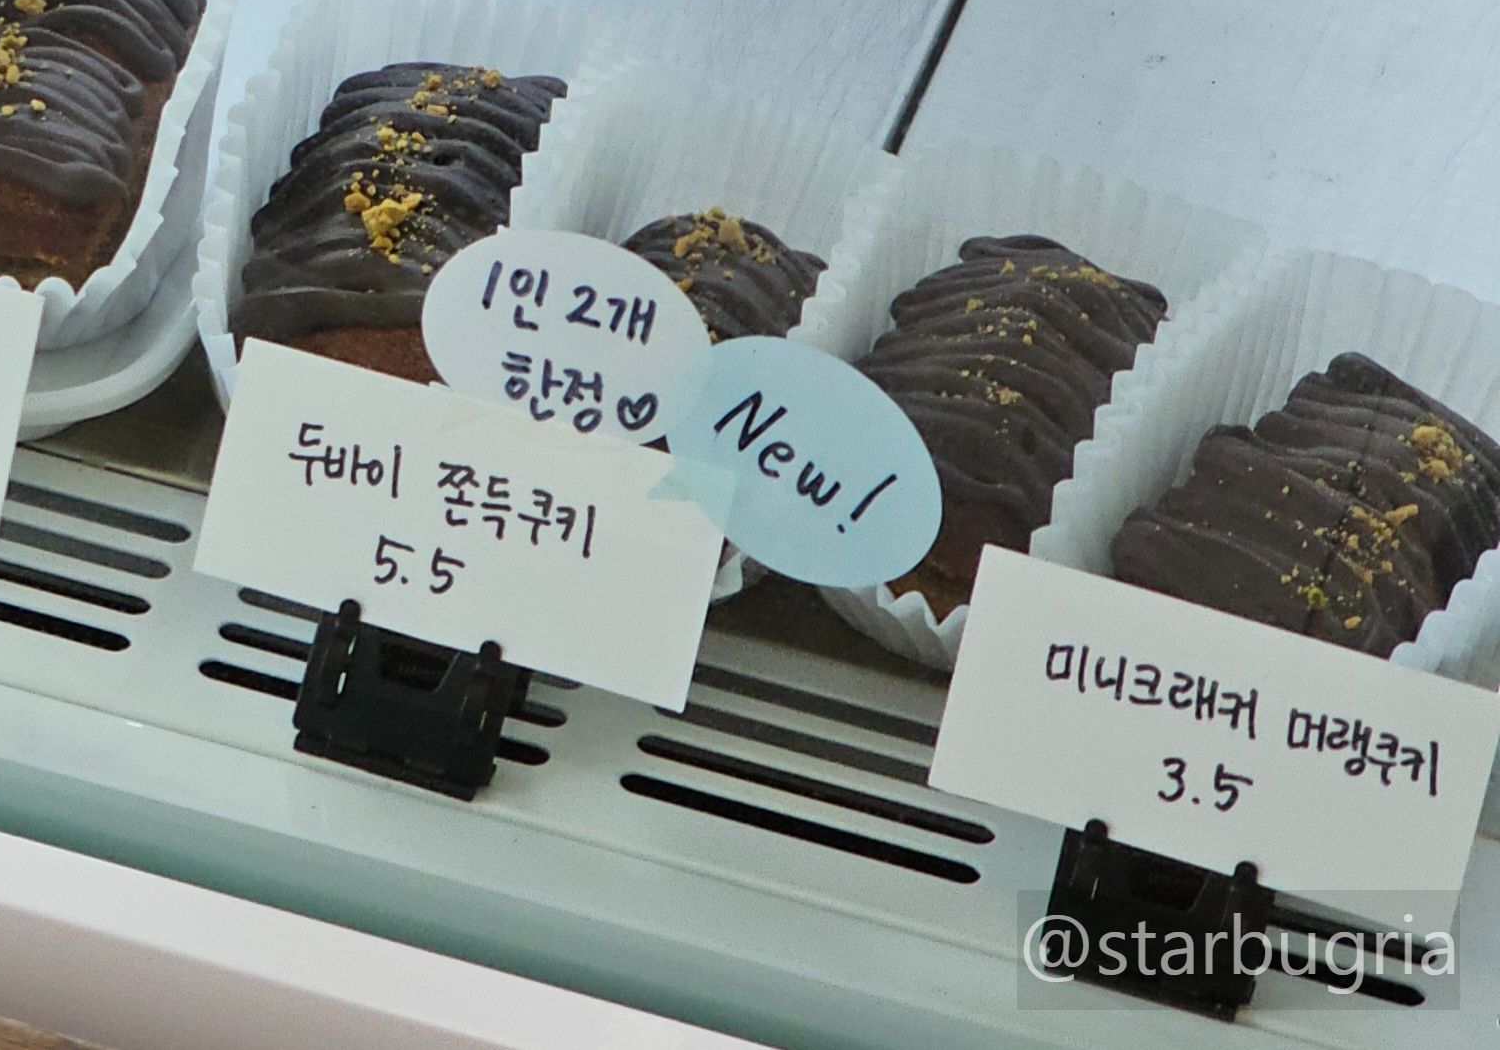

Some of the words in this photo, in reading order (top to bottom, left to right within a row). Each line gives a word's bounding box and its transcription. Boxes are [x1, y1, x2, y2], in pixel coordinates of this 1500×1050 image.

[481, 260, 550, 333] 1인
[564, 284, 658, 347] 2개
[287, 421, 403, 500] 두바이
[436, 460, 597, 560] 쫀득쿠키
[713, 391, 898, 535] New!
[373, 534, 466, 596] 5.5
[1044, 642, 1260, 741] 미니크래커
[1285, 707, 1440, 798] 머랭쿠키
[1156, 756, 1255, 813] 3.5
